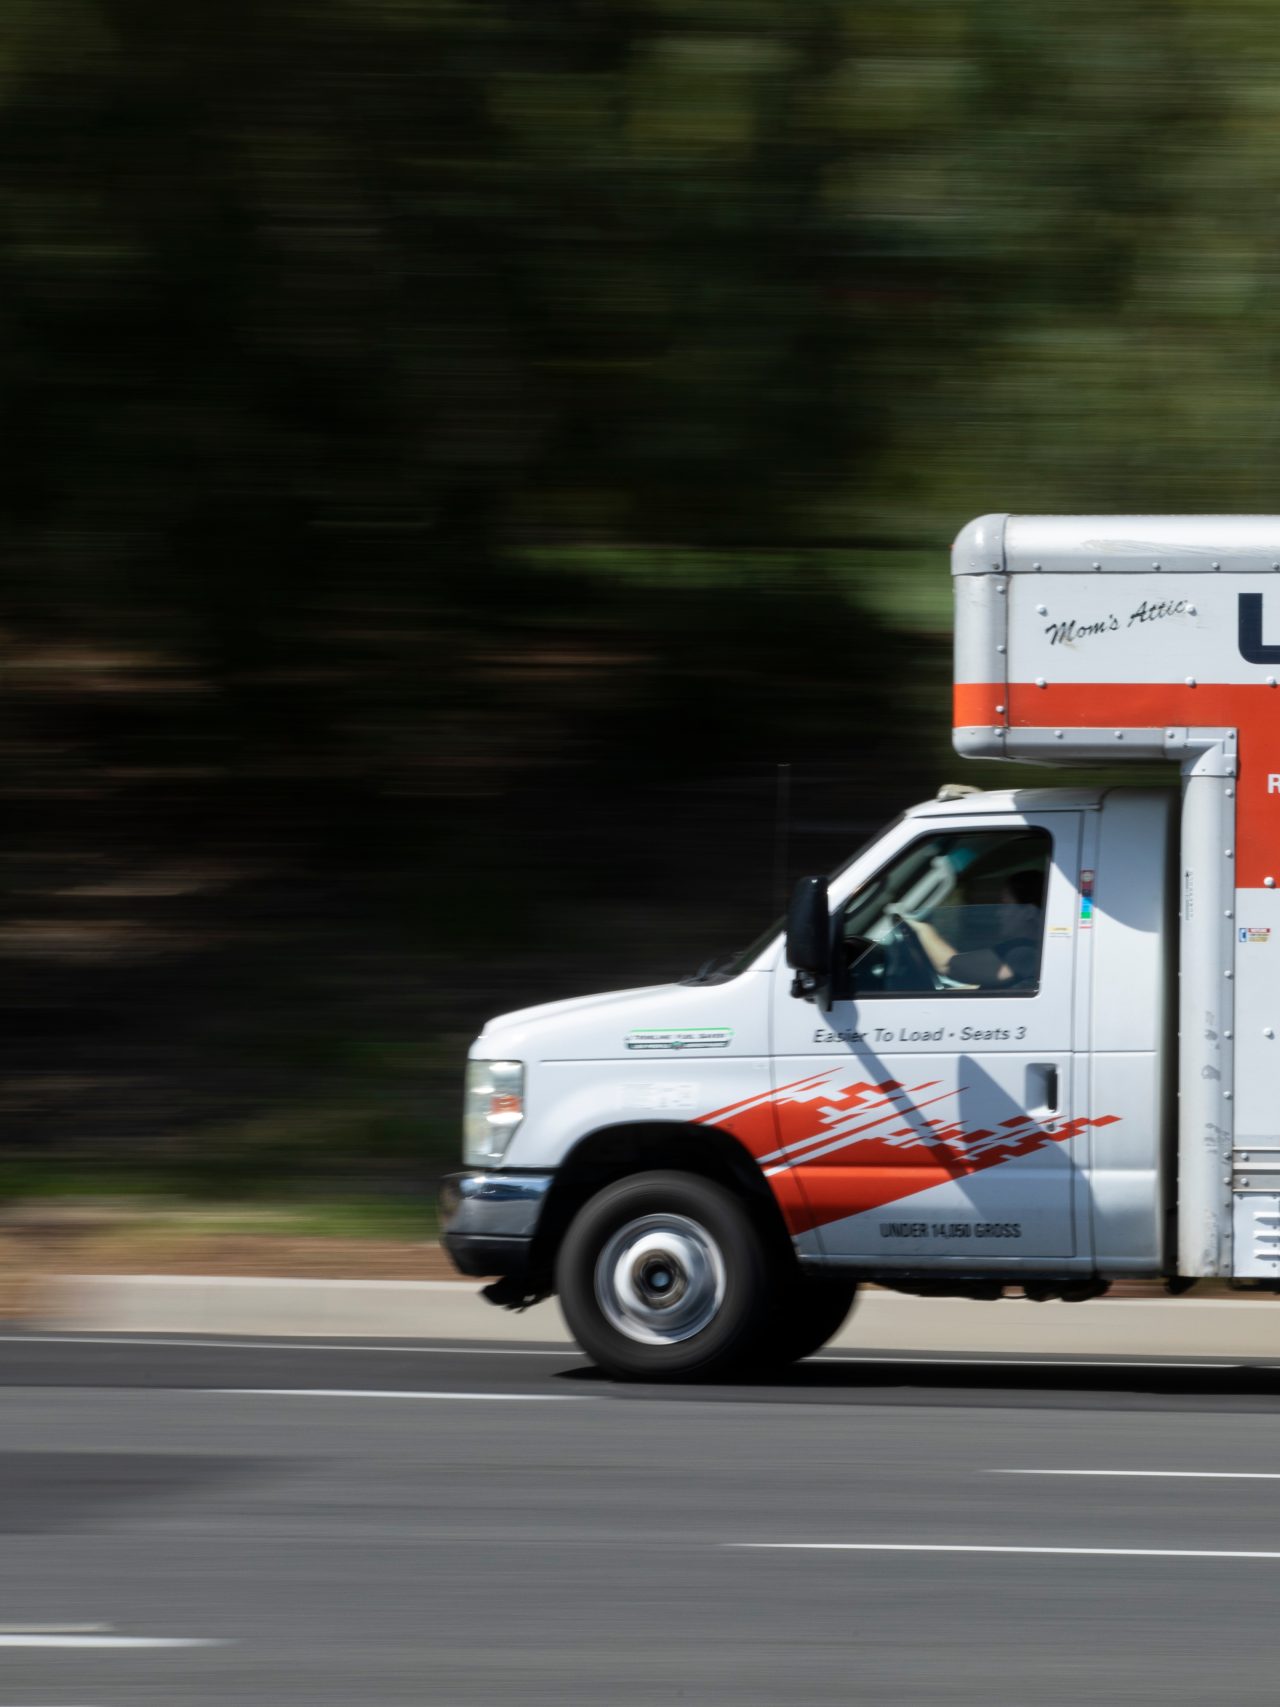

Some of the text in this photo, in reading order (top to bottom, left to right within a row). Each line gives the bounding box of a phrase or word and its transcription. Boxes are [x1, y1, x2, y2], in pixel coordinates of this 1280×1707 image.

[1045, 599, 1188, 646] Mom's Attic
[813, 1026, 1027, 1043] Easier To Load Seats 3
[879, 1223, 929, 1238] UNDER
[974, 1223, 1022, 1238] GROSS
